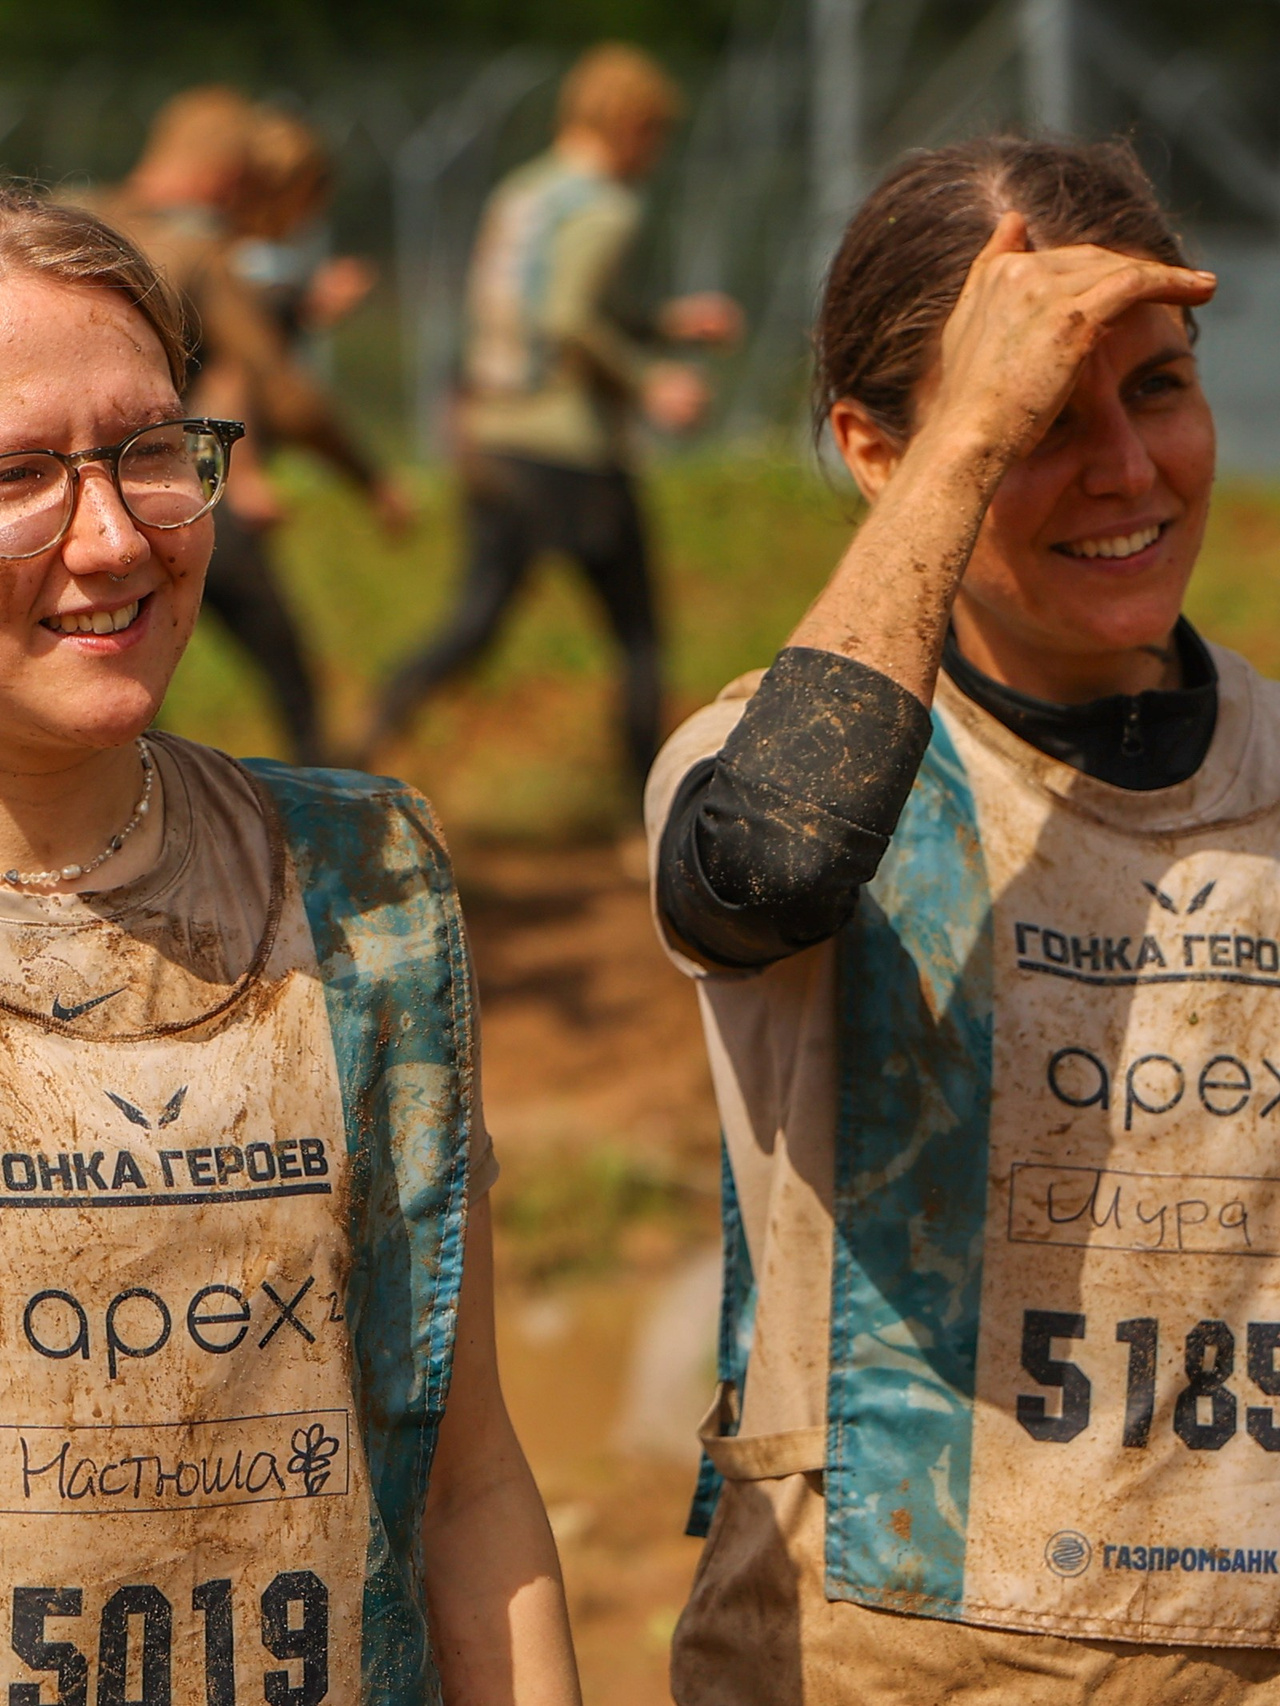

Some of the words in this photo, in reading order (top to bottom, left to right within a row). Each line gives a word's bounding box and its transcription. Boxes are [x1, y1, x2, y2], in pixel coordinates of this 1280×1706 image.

[1015, 921, 1166, 971] ГОНКА
[159, 1138, 329, 1188] ГЕРОЕВ
[19, 1436, 286, 1499] Настюша
[1103, 1545, 1279, 1574] ГАЗПРОМБАНК
[9, 1570, 329, 1706] 5019
